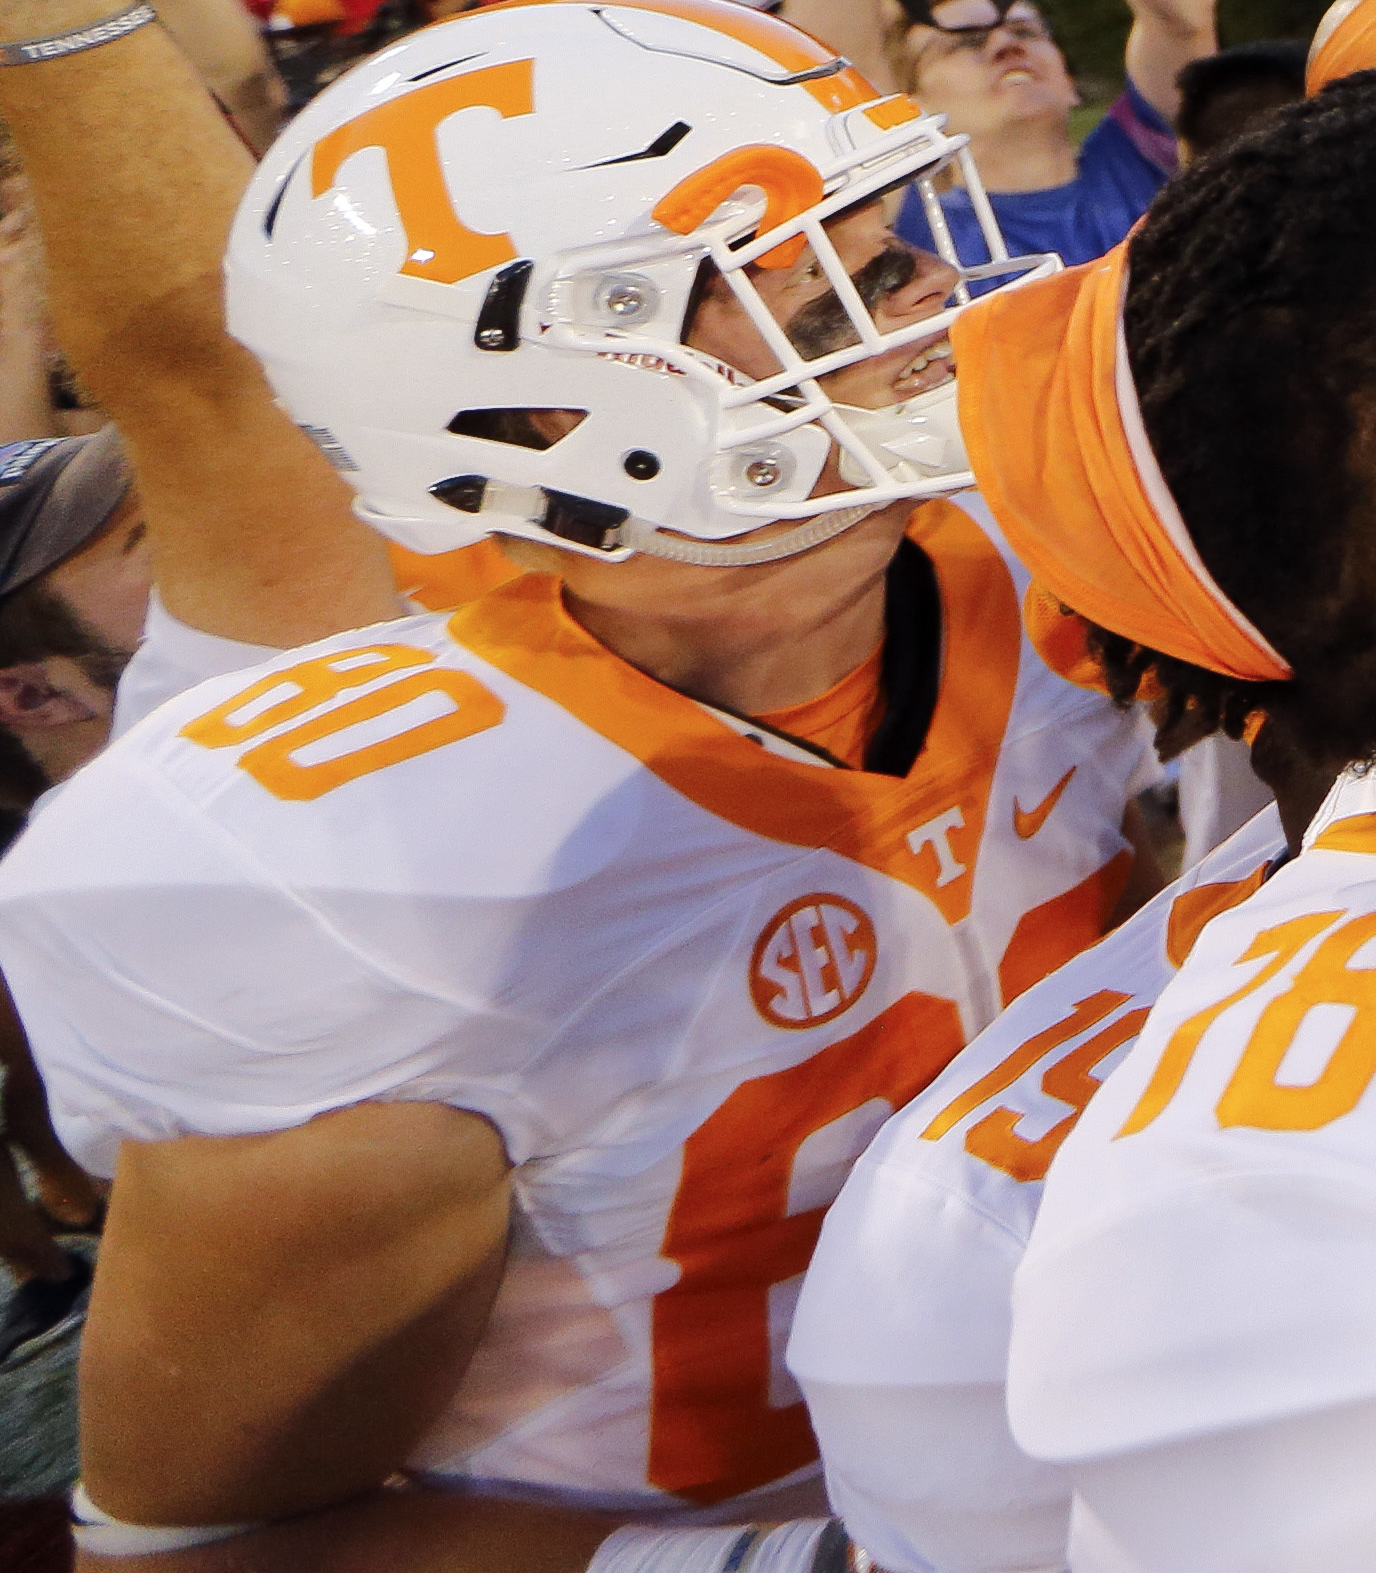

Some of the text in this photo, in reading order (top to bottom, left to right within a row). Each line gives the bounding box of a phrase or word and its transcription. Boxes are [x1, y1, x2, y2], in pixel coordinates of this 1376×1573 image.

[312, 57, 534, 284] T
[179, 644, 506, 802] 80
[906, 805, 967, 888] T
[759, 904, 869, 1021] SEC
